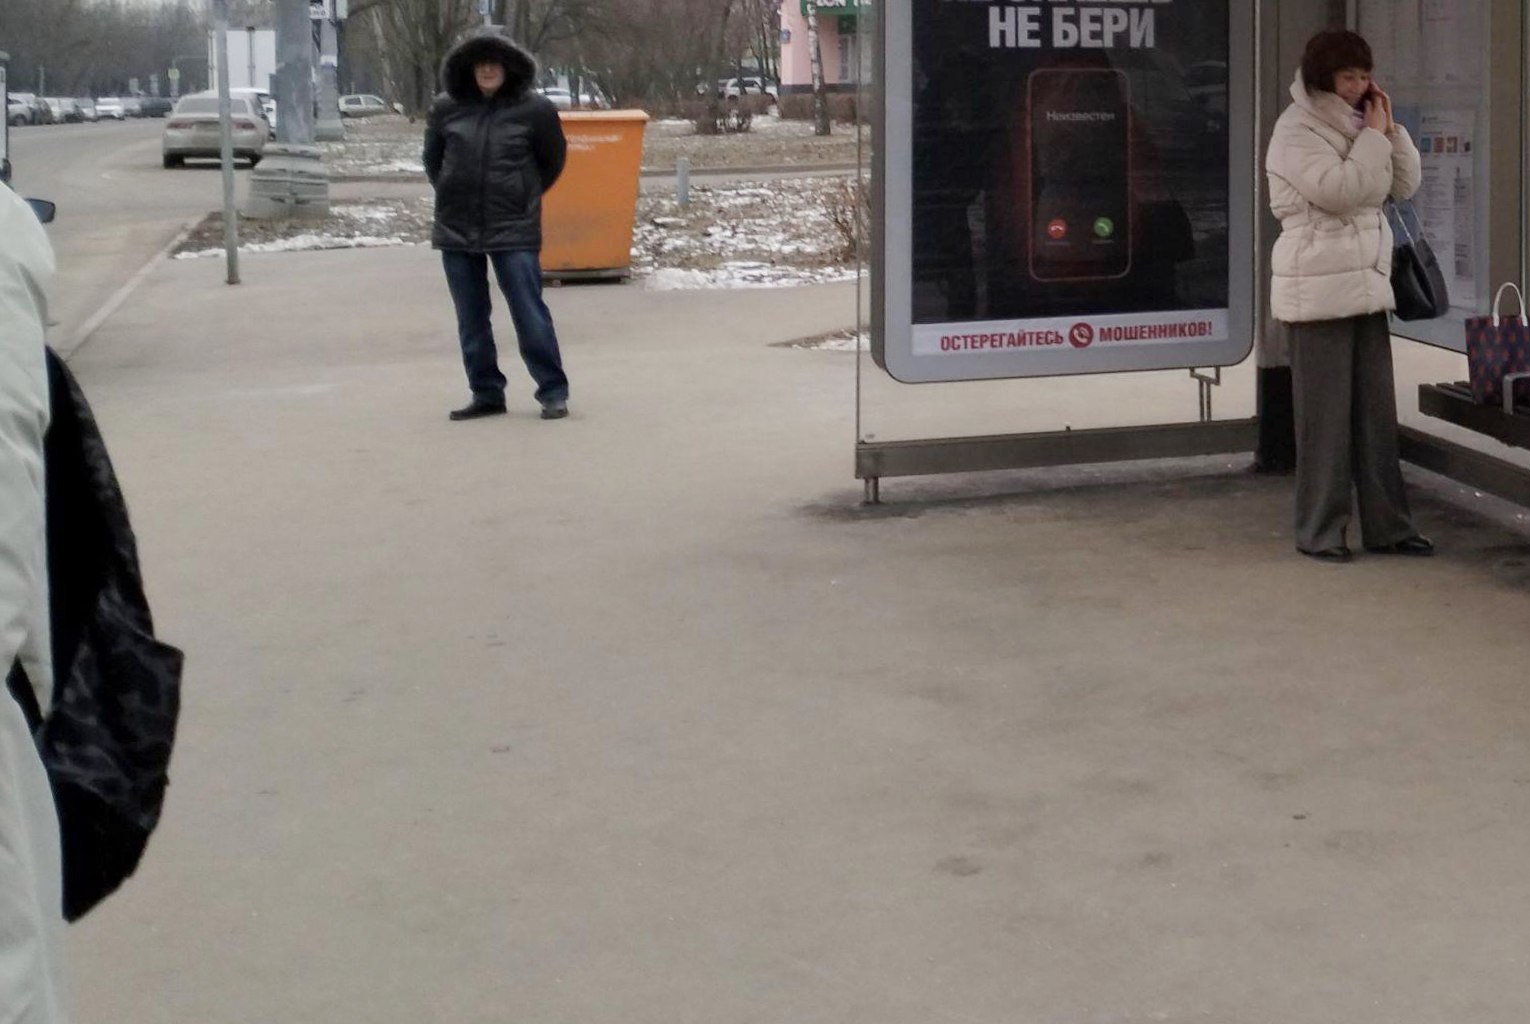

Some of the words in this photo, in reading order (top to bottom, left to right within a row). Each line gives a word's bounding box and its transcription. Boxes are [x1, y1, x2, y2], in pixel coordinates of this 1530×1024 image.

[988, 6, 1042, 49] НЕ
[1052, 7, 1156, 49] БЕРИ
[940, 329, 1065, 352] ОСТЕРЕГАЙТЕСЬ
[1099, 320, 1213, 343] МОШЕННИКОВ!
